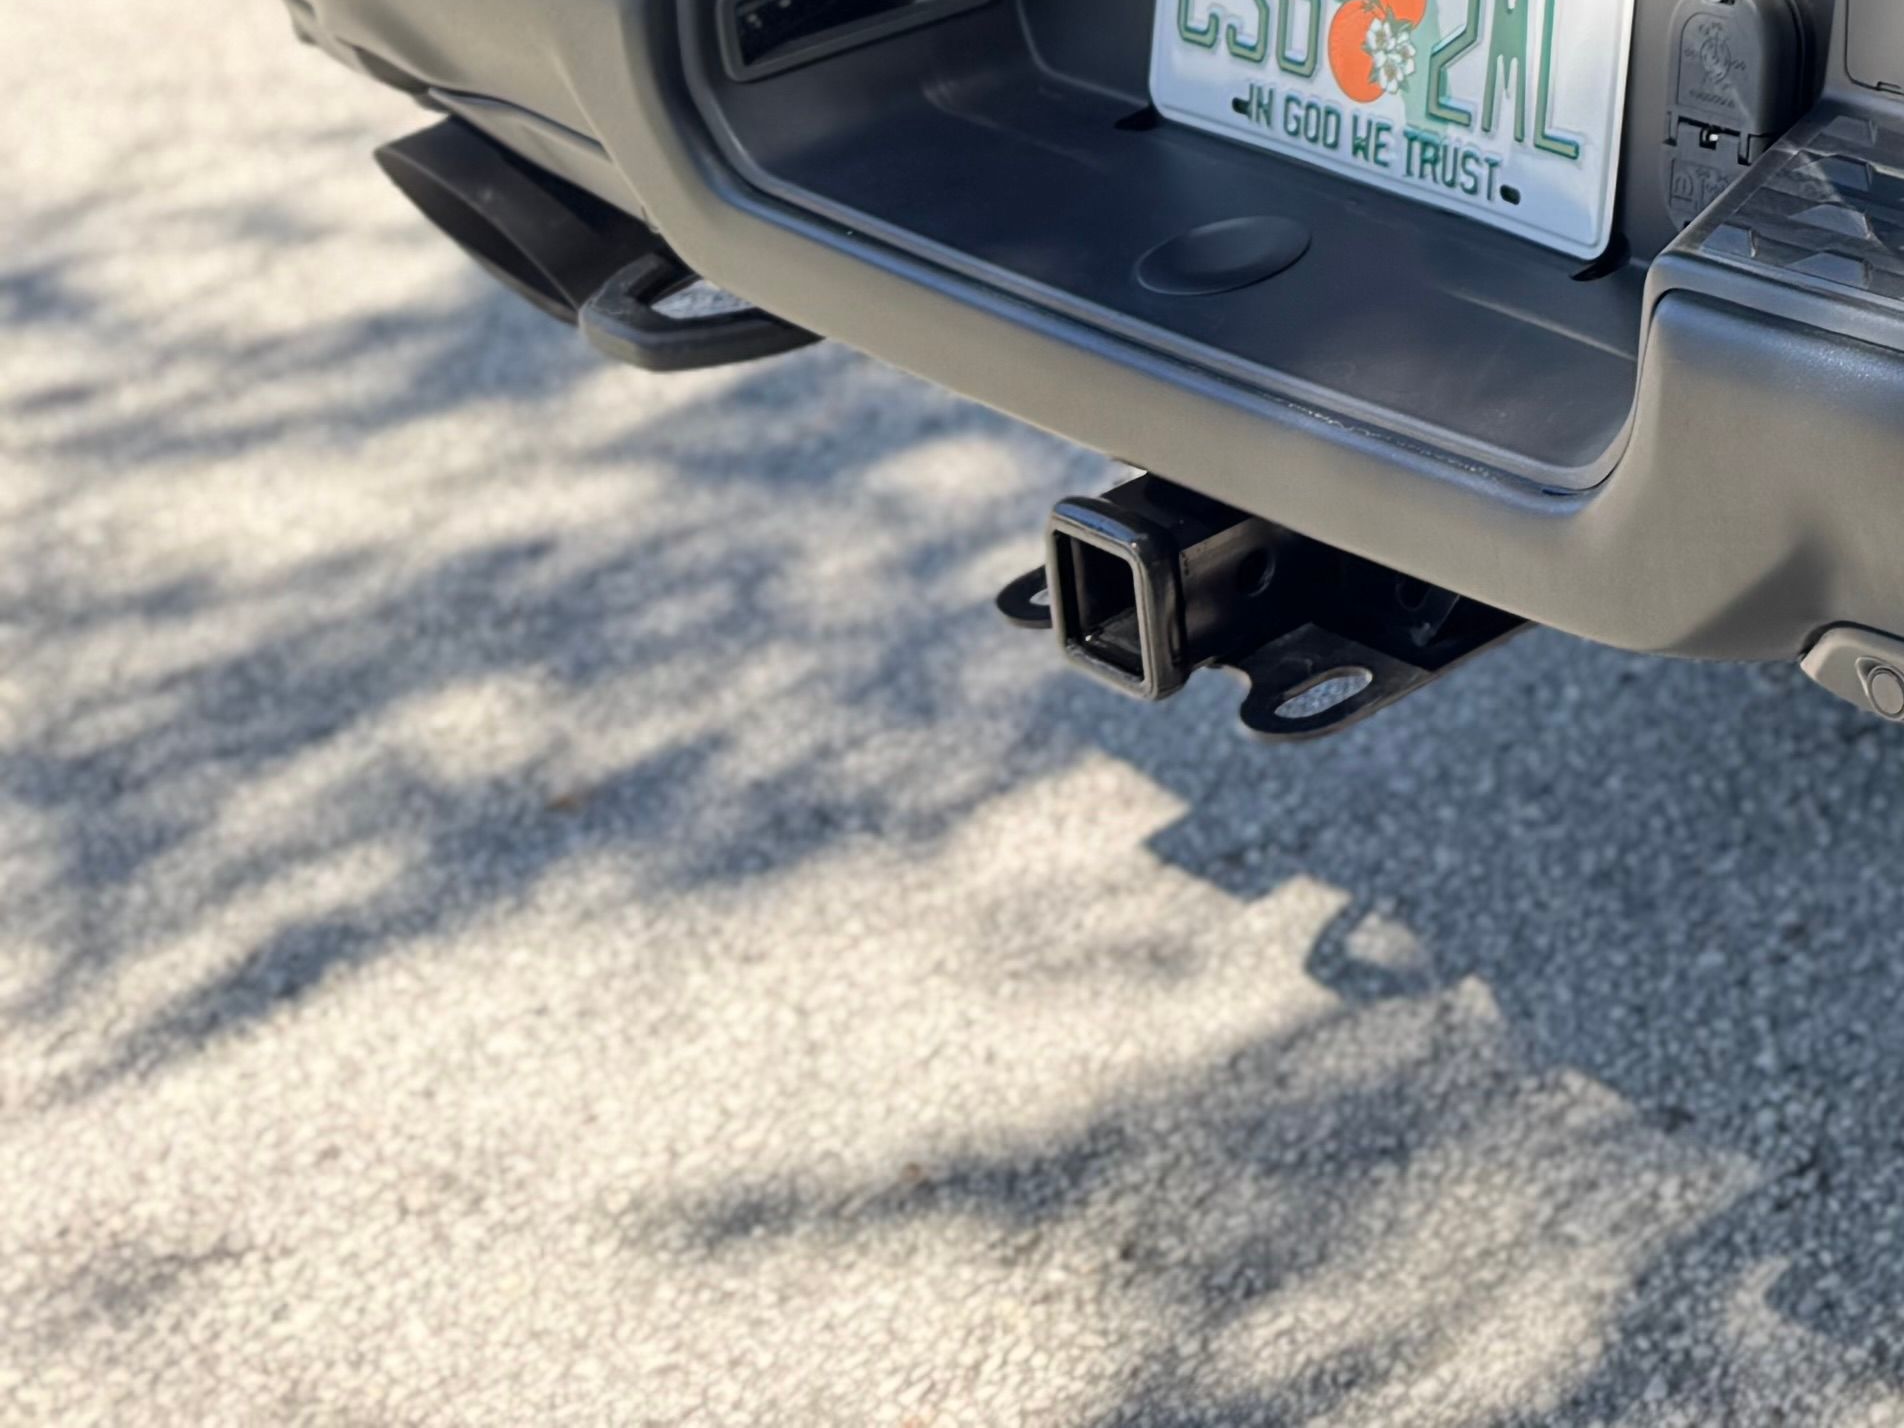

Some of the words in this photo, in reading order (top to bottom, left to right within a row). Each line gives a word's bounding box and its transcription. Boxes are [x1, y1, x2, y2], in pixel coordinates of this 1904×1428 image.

[1249, 83, 1275, 127] IN
[1284, 94, 1341, 150] GOD
[1352, 113, 1392, 168] WE
[1404, 127, 1502, 201] TRUST
